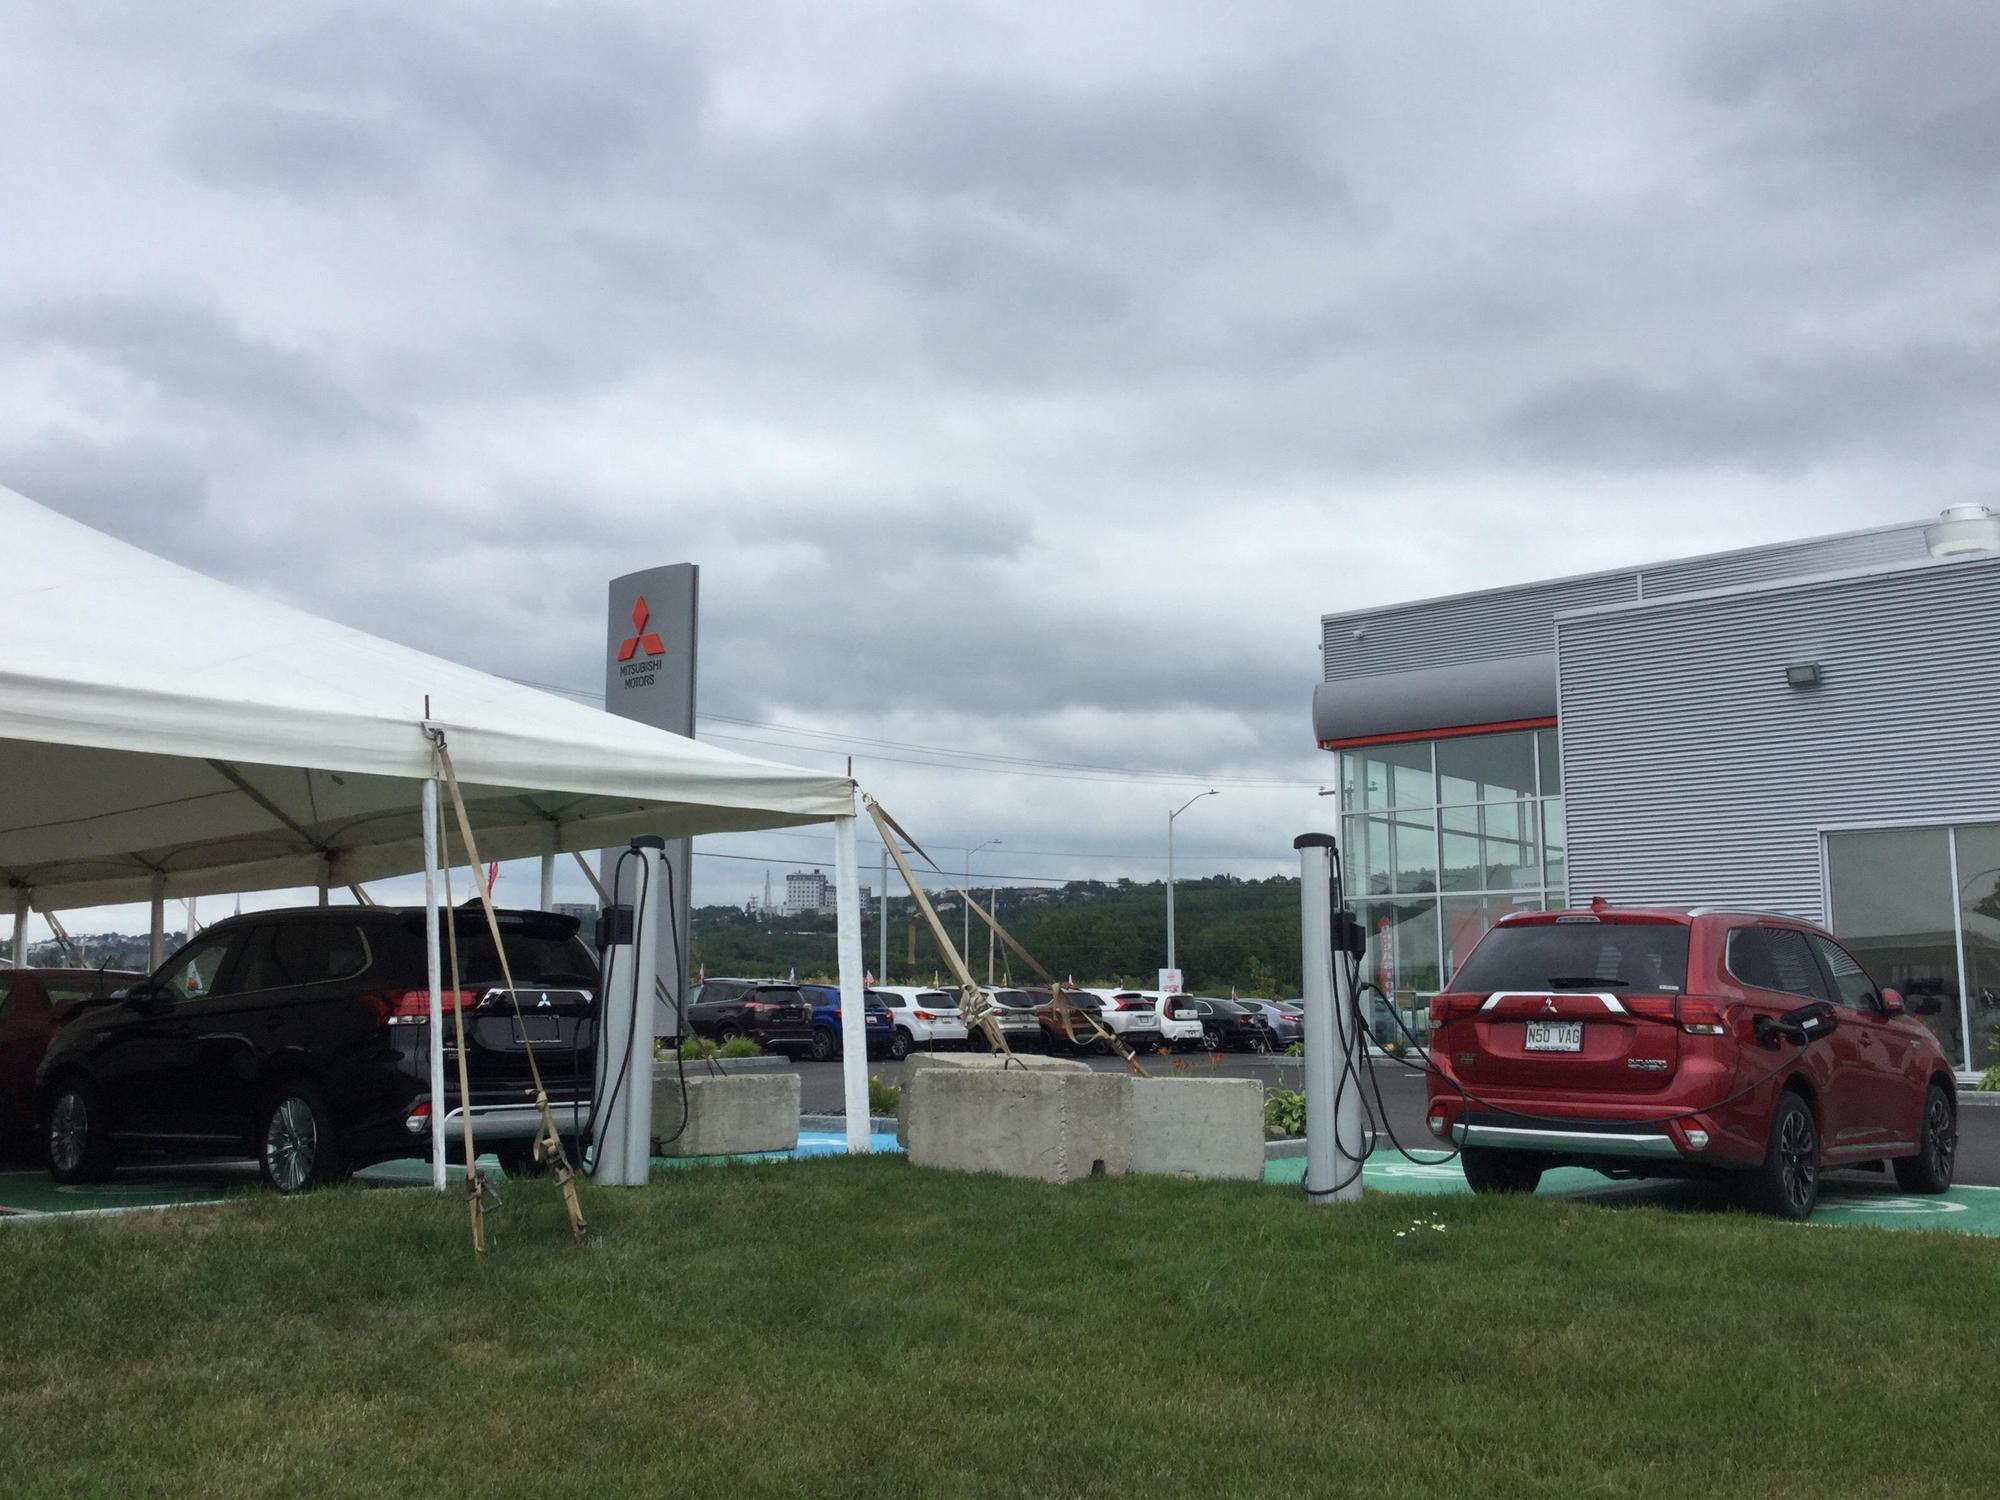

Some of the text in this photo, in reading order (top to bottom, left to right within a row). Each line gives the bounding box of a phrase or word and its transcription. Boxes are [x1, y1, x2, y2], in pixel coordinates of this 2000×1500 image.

[620, 660, 662, 677] MITSUBISHI
[625, 675, 655, 689] MOTORS
[1528, 1028, 1580, 1044] N50 VAG
